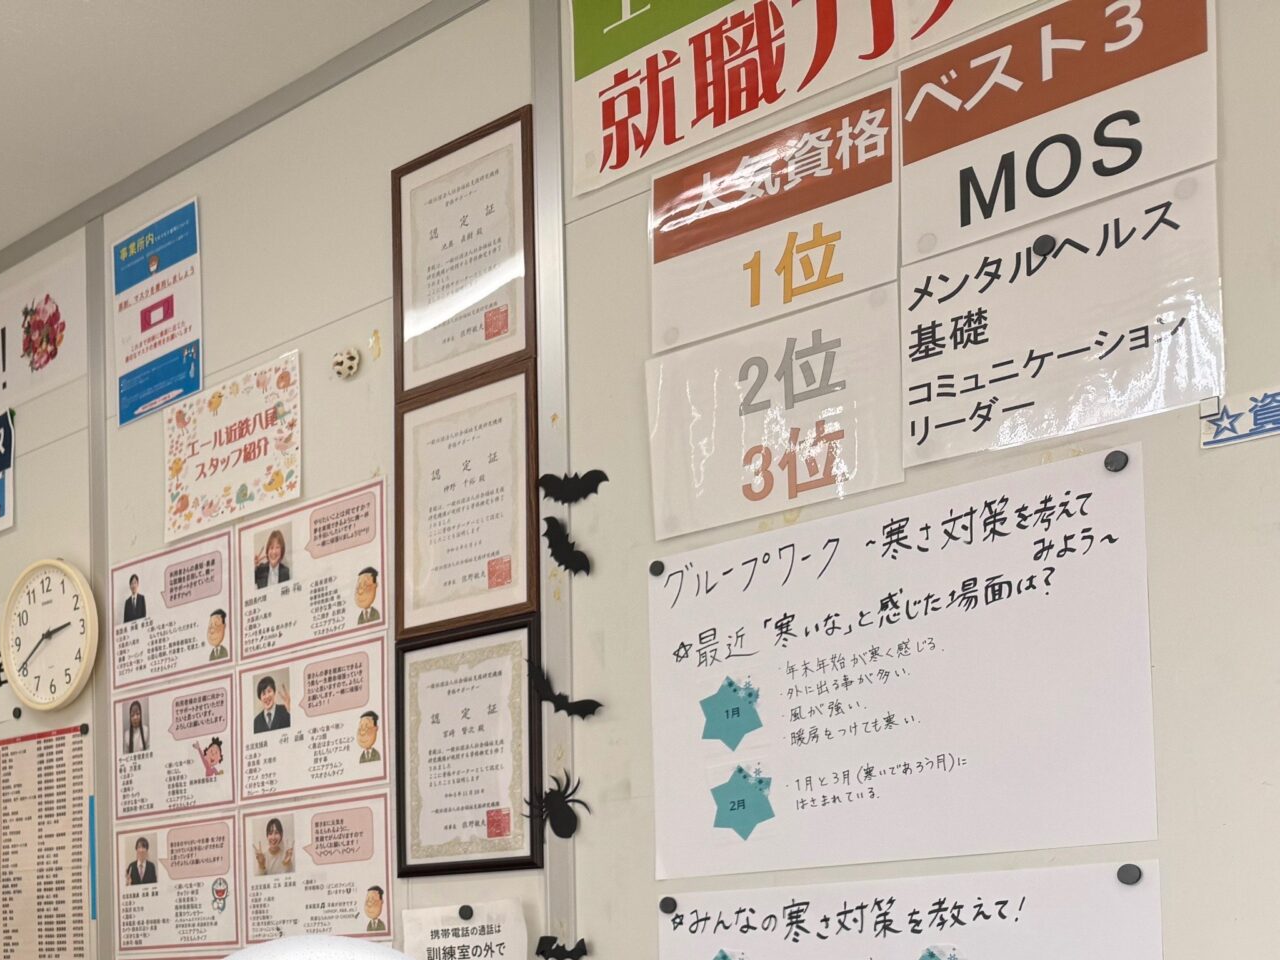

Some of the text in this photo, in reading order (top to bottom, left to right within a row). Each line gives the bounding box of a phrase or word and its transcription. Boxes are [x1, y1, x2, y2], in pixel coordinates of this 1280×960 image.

[958, 110, 1143, 227] MOS
[908, 200, 1181, 310] メンタルヘルス
[742, 222, 843, 307] 1位
[909, 308, 990, 362] 基礎
[909, 316, 1186, 406] コミュニケーション
[738, 330, 847, 416] 2位
[909, 399, 1035, 446] リーダー
[187, 406, 279, 458] エール近鉄八尾
[195, 437, 270, 481] スタッフ紹介
[741, 419, 850, 502] 3位
[664, 538, 840, 609] グループワーク
[40, 576, 52, 594] 12
[60, 579, 65, 594] 1
[26, 588, 36, 605] 11
[73, 594, 80, 611] 2
[17, 610, 28, 627] 10
[79, 619, 85, 635] 3
[15, 637, 21, 652] 9
[75, 648, 81, 662] 4
[22, 662, 28, 677] 8
[65, 668, 71, 684] 5
[34, 675, 40, 691] 7
[50, 678, 56, 694] 6
[724, 707, 740, 719] 1月
[729, 799, 746, 811] 2月
[430, 923, 502, 941] 携帯電話の通話は
